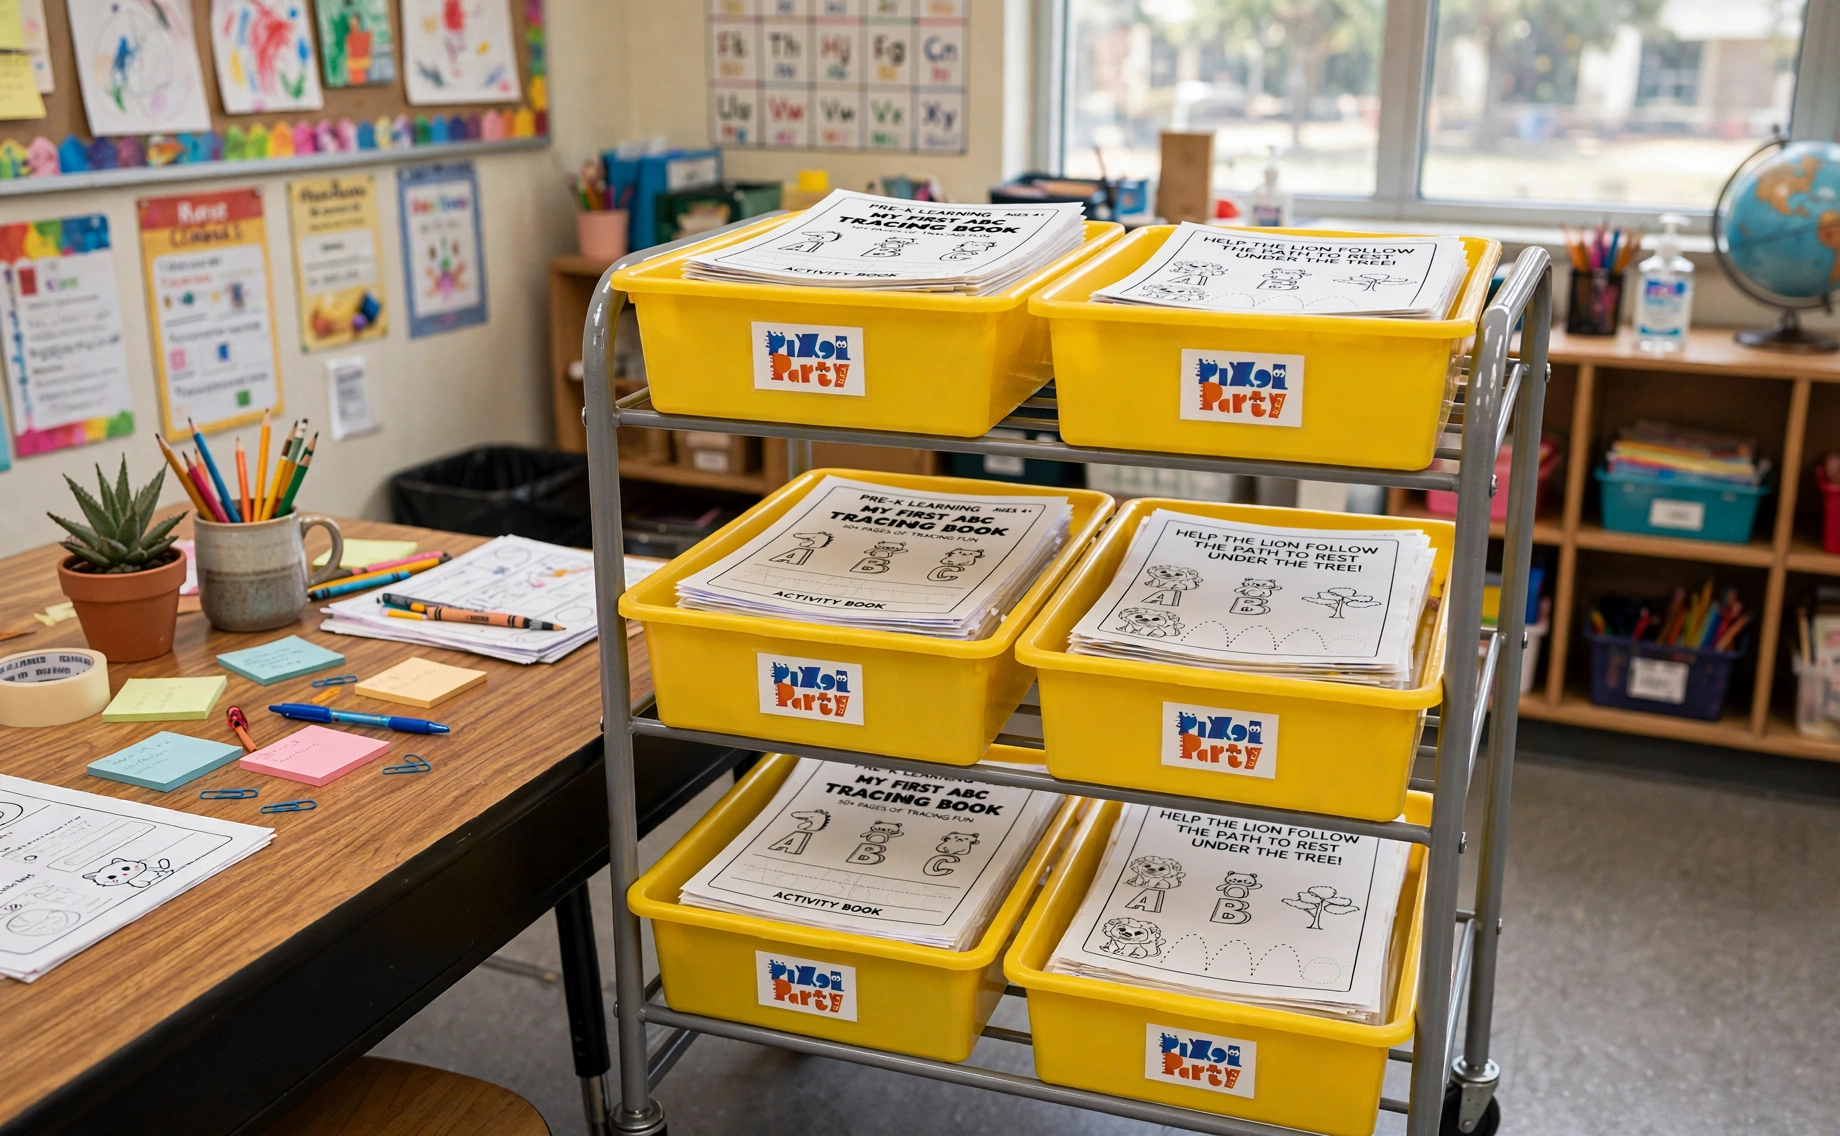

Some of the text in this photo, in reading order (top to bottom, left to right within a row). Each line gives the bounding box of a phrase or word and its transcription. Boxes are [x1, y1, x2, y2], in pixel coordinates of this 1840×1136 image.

[869, 203, 913, 213] PRE-K
[918, 209, 992, 218] LEARNING
[869, 212, 1006, 226] MY FIRST ABC
[839, 216, 1020, 234] TRACING BOOK
[1203, 236, 1247, 246] HELP
[1222, 245, 1256, 253] THE
[1262, 249, 1311, 257] PATH
[1235, 252, 1299, 262] UNDER
[784, 267, 852, 277] ACTIVITY
[770, 353, 850, 388] Party
[1199, 381, 1287, 419] Party
[859, 505, 996, 524] MY FIRST ABC
[860, 494, 904, 506] PRE-K
[907, 500, 981, 513] LEARNING
[830, 511, 1010, 537] TRACING BOOK
[1176, 529, 1379, 555] HELP THE LION FOLLOW
[1193, 540, 1359, 563] THE PATH TO REST
[1207, 551, 1363, 573] UNDER THE TREE!
[772, 590, 888, 610] ACTIVITY BOOK
[775, 682, 850, 717] Party
[1179, 733, 1262, 770] Party
[825, 782, 1004, 816] TRACING BOOK
[855, 774, 990, 800] MY FIRST ABC
[857, 802, 887, 812] PAGES
[952, 815, 975, 823] FUN
[1160, 810, 1360, 844] HELP THE LION FOLLOW
[1176, 824, 1340, 853] THE PATH TO REST
[1191, 838, 1342, 866] UNDER THE TREE!
[773, 891, 883, 916] ACTIVITY BOOK
[773, 978, 844, 1013] Party
[1161, 1052, 1241, 1089] Party
